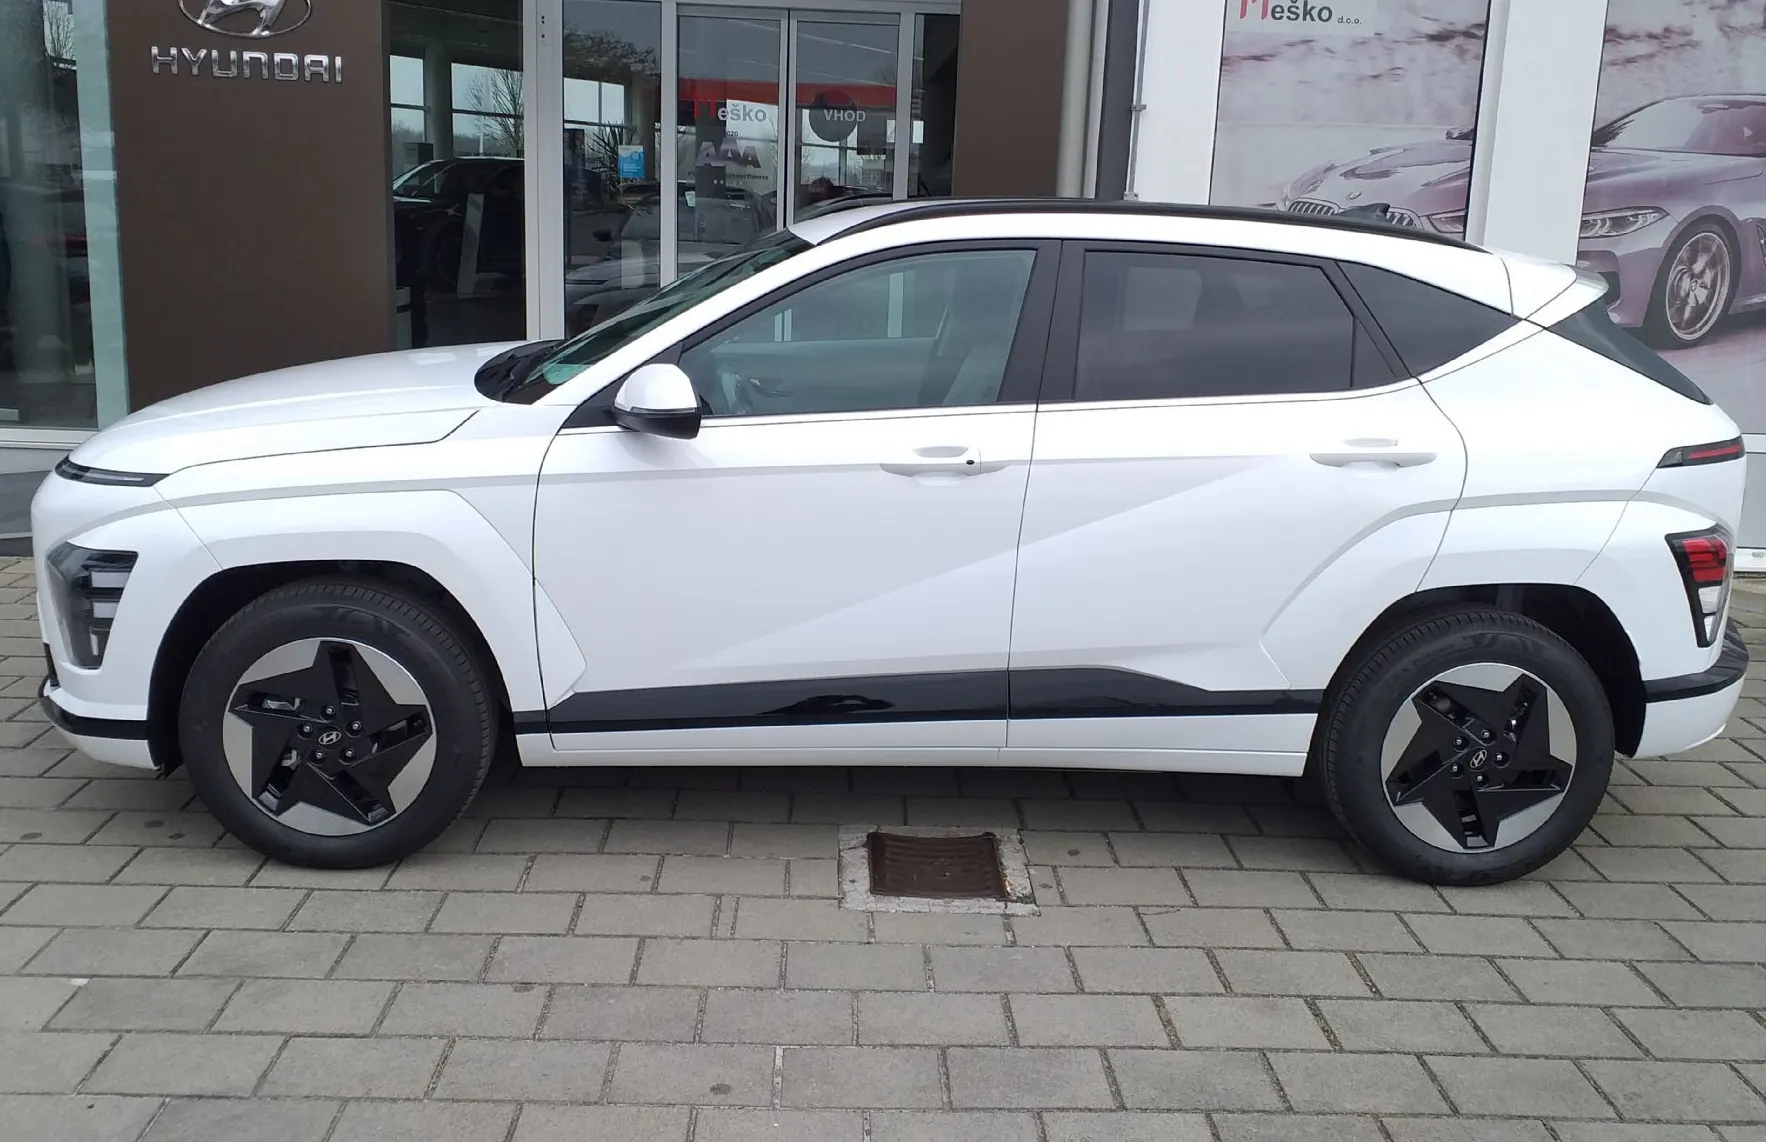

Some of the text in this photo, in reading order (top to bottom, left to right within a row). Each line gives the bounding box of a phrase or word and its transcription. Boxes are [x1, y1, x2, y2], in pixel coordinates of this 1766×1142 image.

[1337, 15, 1362, 24] d.o.o.
[151, 46, 343, 83] HYUNDAI
[823, 109, 866, 122] VHOD
[695, 136, 761, 168] AAA
